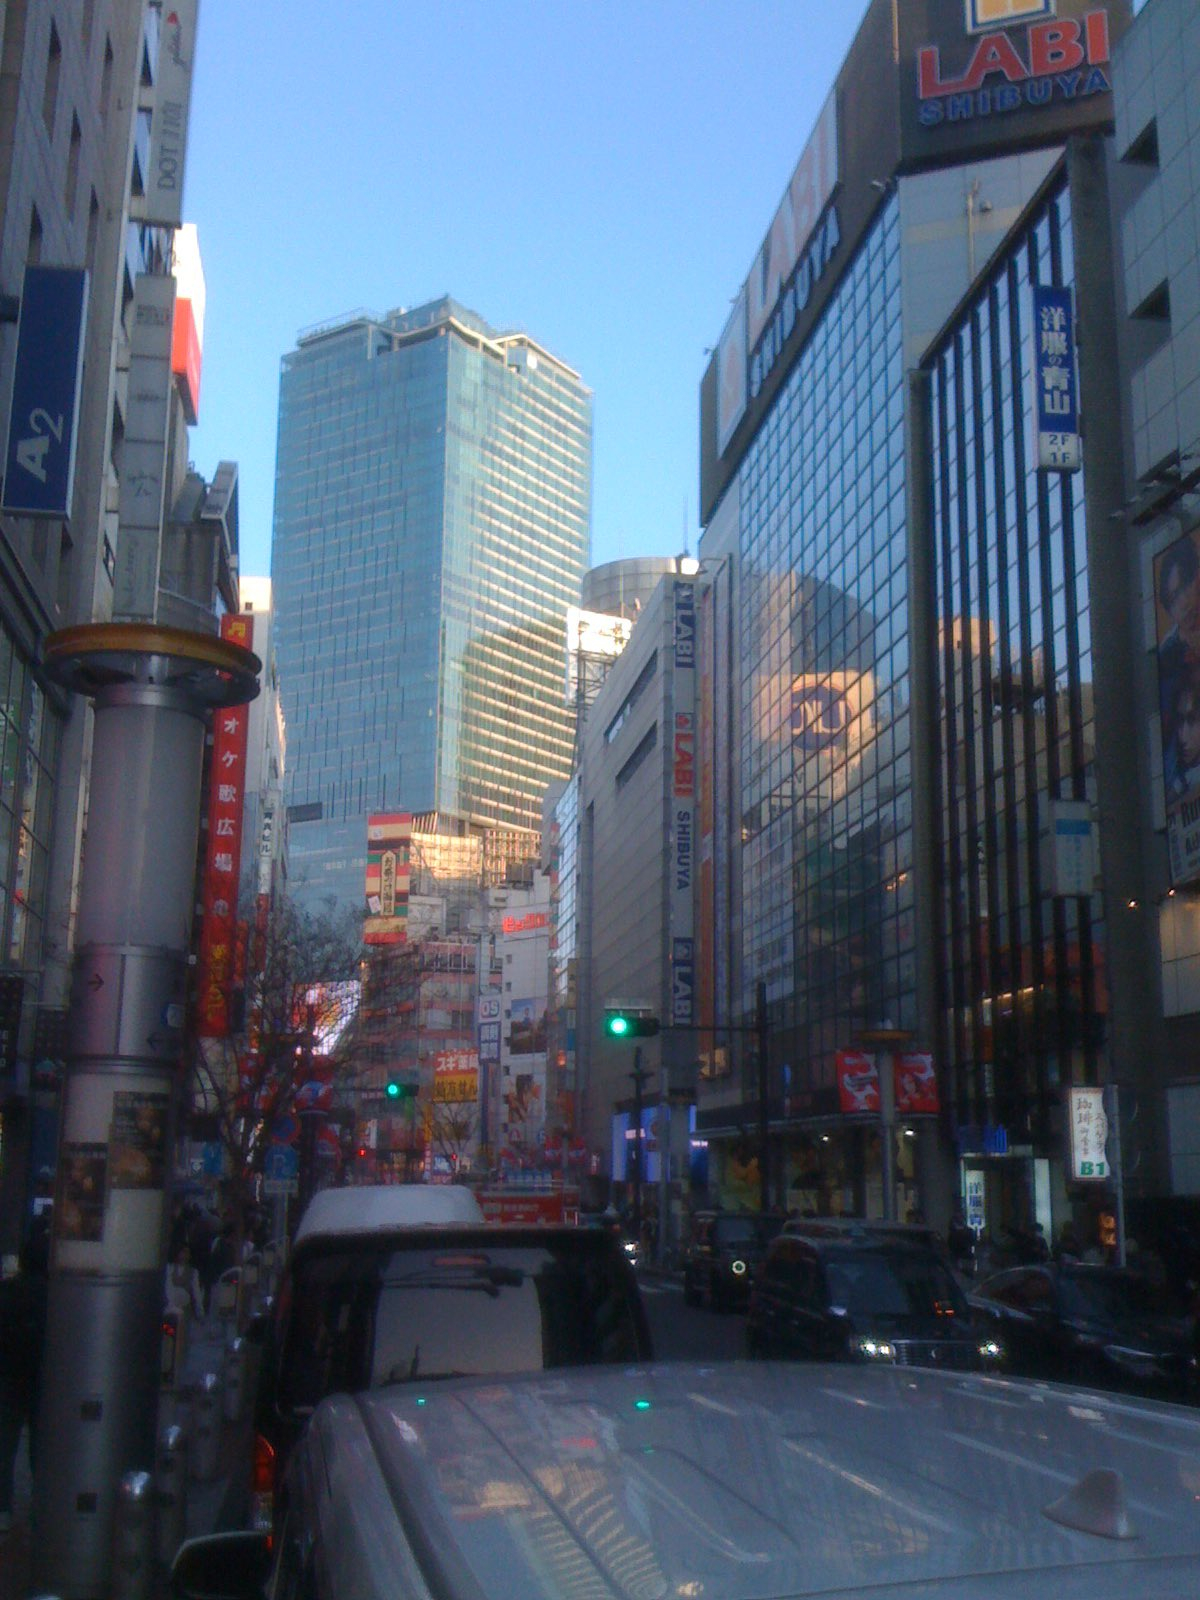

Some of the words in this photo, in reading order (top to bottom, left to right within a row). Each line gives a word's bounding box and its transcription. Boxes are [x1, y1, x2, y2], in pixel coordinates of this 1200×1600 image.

[917, 8, 1110, 99] LABI
[918, 68, 1112, 126] SHIBUYA
[1041, 306, 1071, 414] 洋服の青山
[16, 407, 64, 482] A2
[1049, 434, 1070, 446] 2F
[1050, 451, 1070, 464] 1F
[674, 601, 694, 668] LABI
[674, 730, 694, 797] LABI
[676, 810, 691, 891] SHIBUYA
[672, 961, 693, 1025] LABI
[1080, 1161, 1105, 1176] B1
